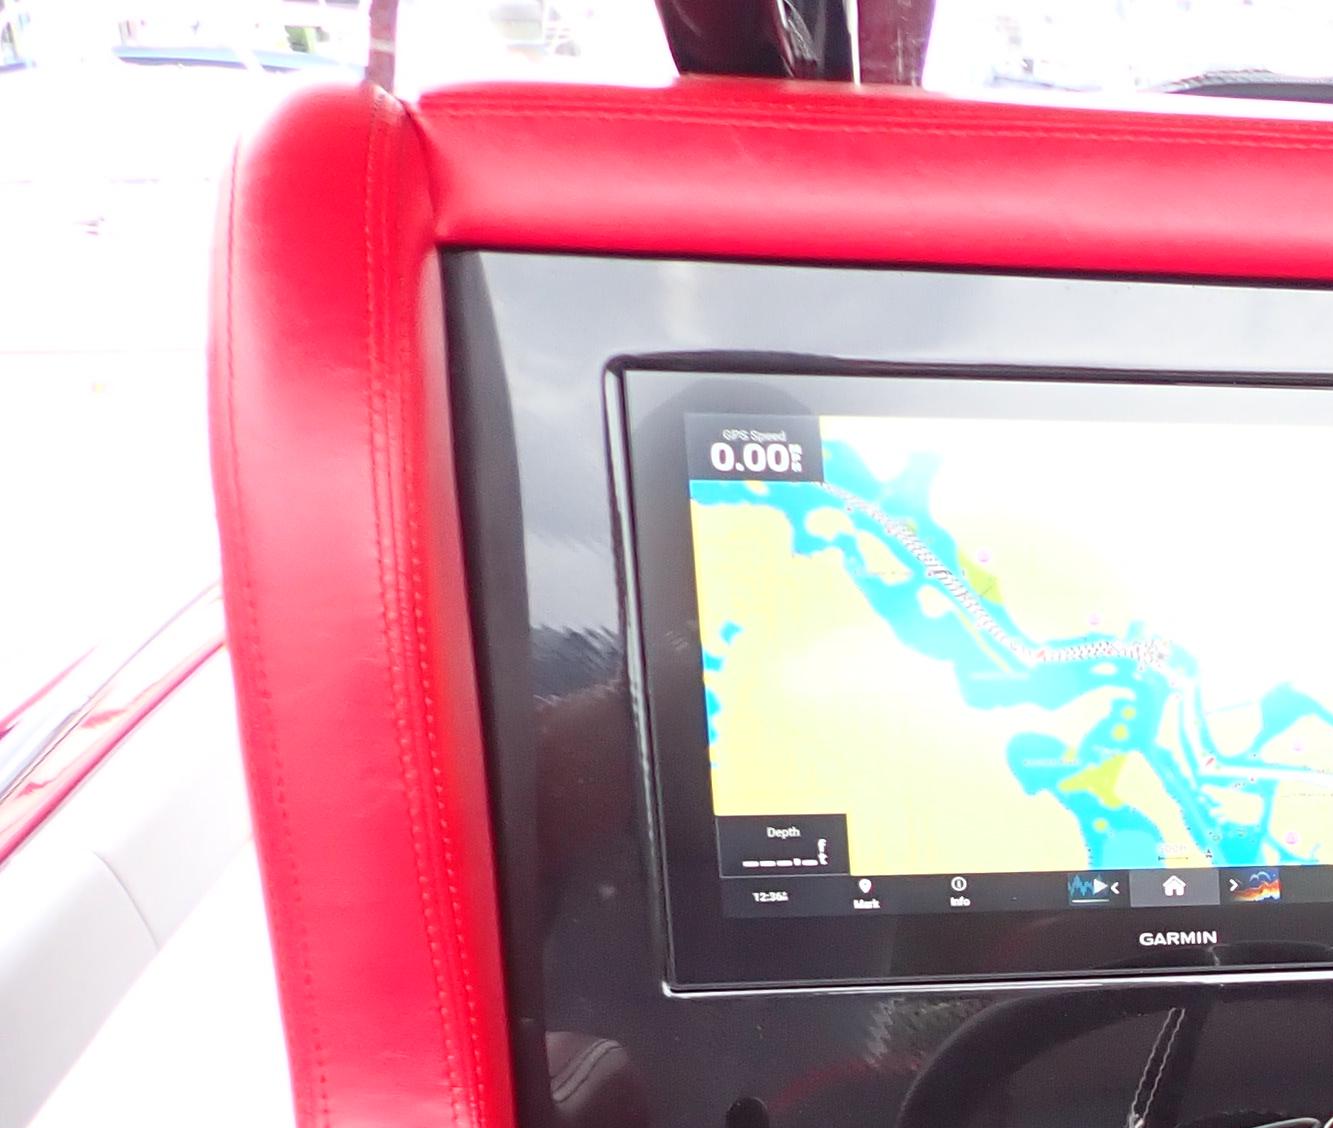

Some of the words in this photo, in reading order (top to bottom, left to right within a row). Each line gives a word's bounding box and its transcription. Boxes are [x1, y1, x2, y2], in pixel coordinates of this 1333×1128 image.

[711, 442, 790, 473] 0.00
[766, 826, 801, 839] Depth
[950, 895, 971, 907] Info
[1138, 930, 1218, 946] GARMIN
